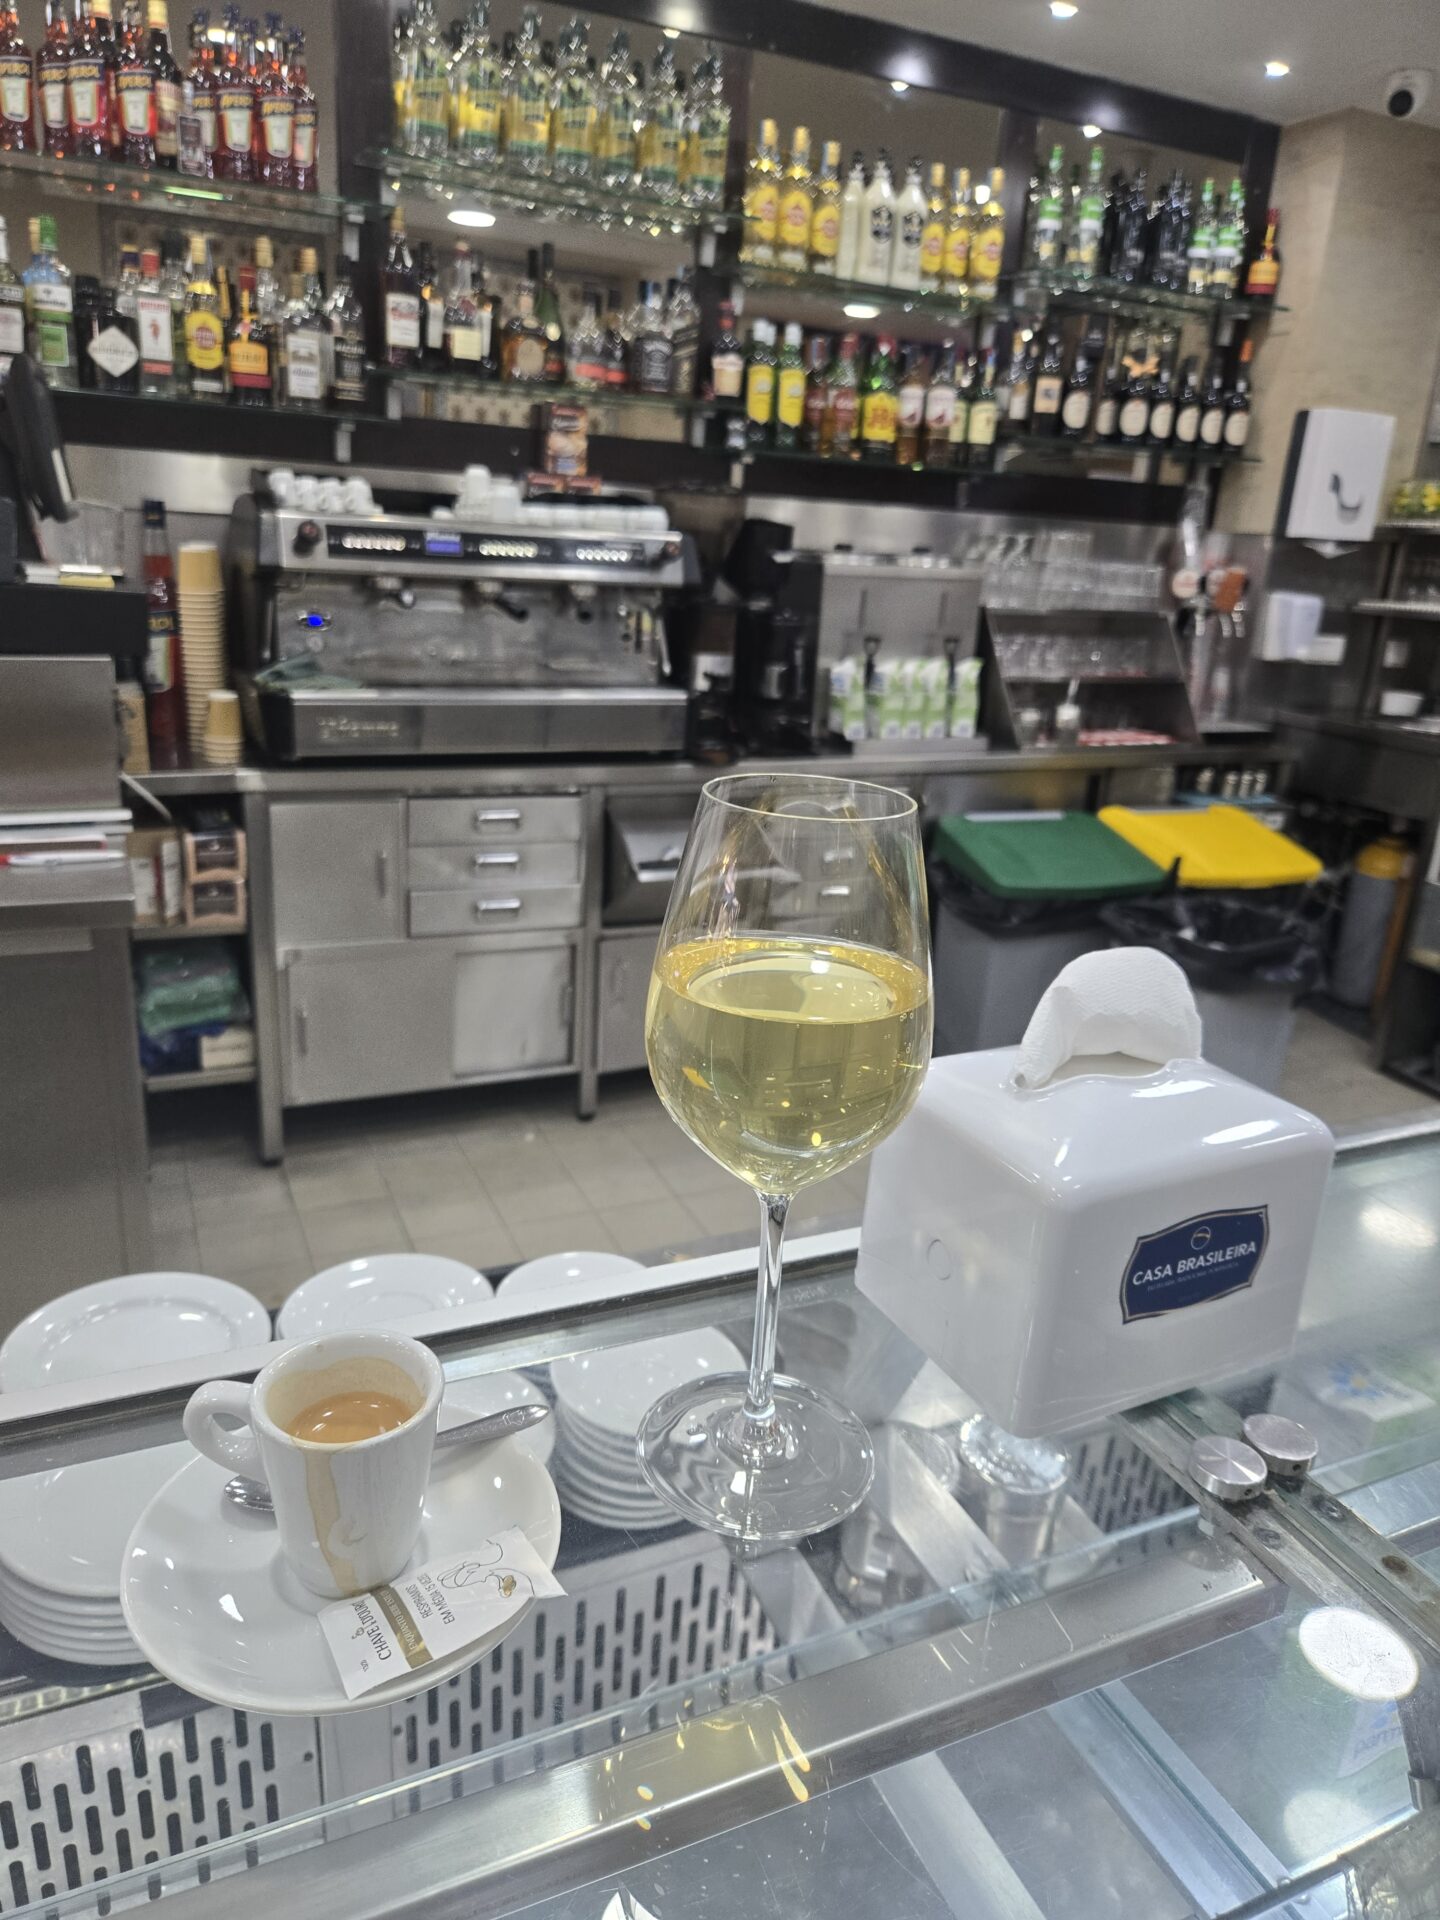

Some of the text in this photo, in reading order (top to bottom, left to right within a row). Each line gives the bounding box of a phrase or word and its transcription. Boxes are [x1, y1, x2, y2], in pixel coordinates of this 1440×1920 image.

[1132, 1264, 1173, 1286] CASA
[1176, 1241, 1257, 1274] BRASILEIRA
[395, 1614, 418, 1650] ENQUANTO
[439, 1608, 455, 1625] EM
[366, 1625, 392, 1661] CHAVE
